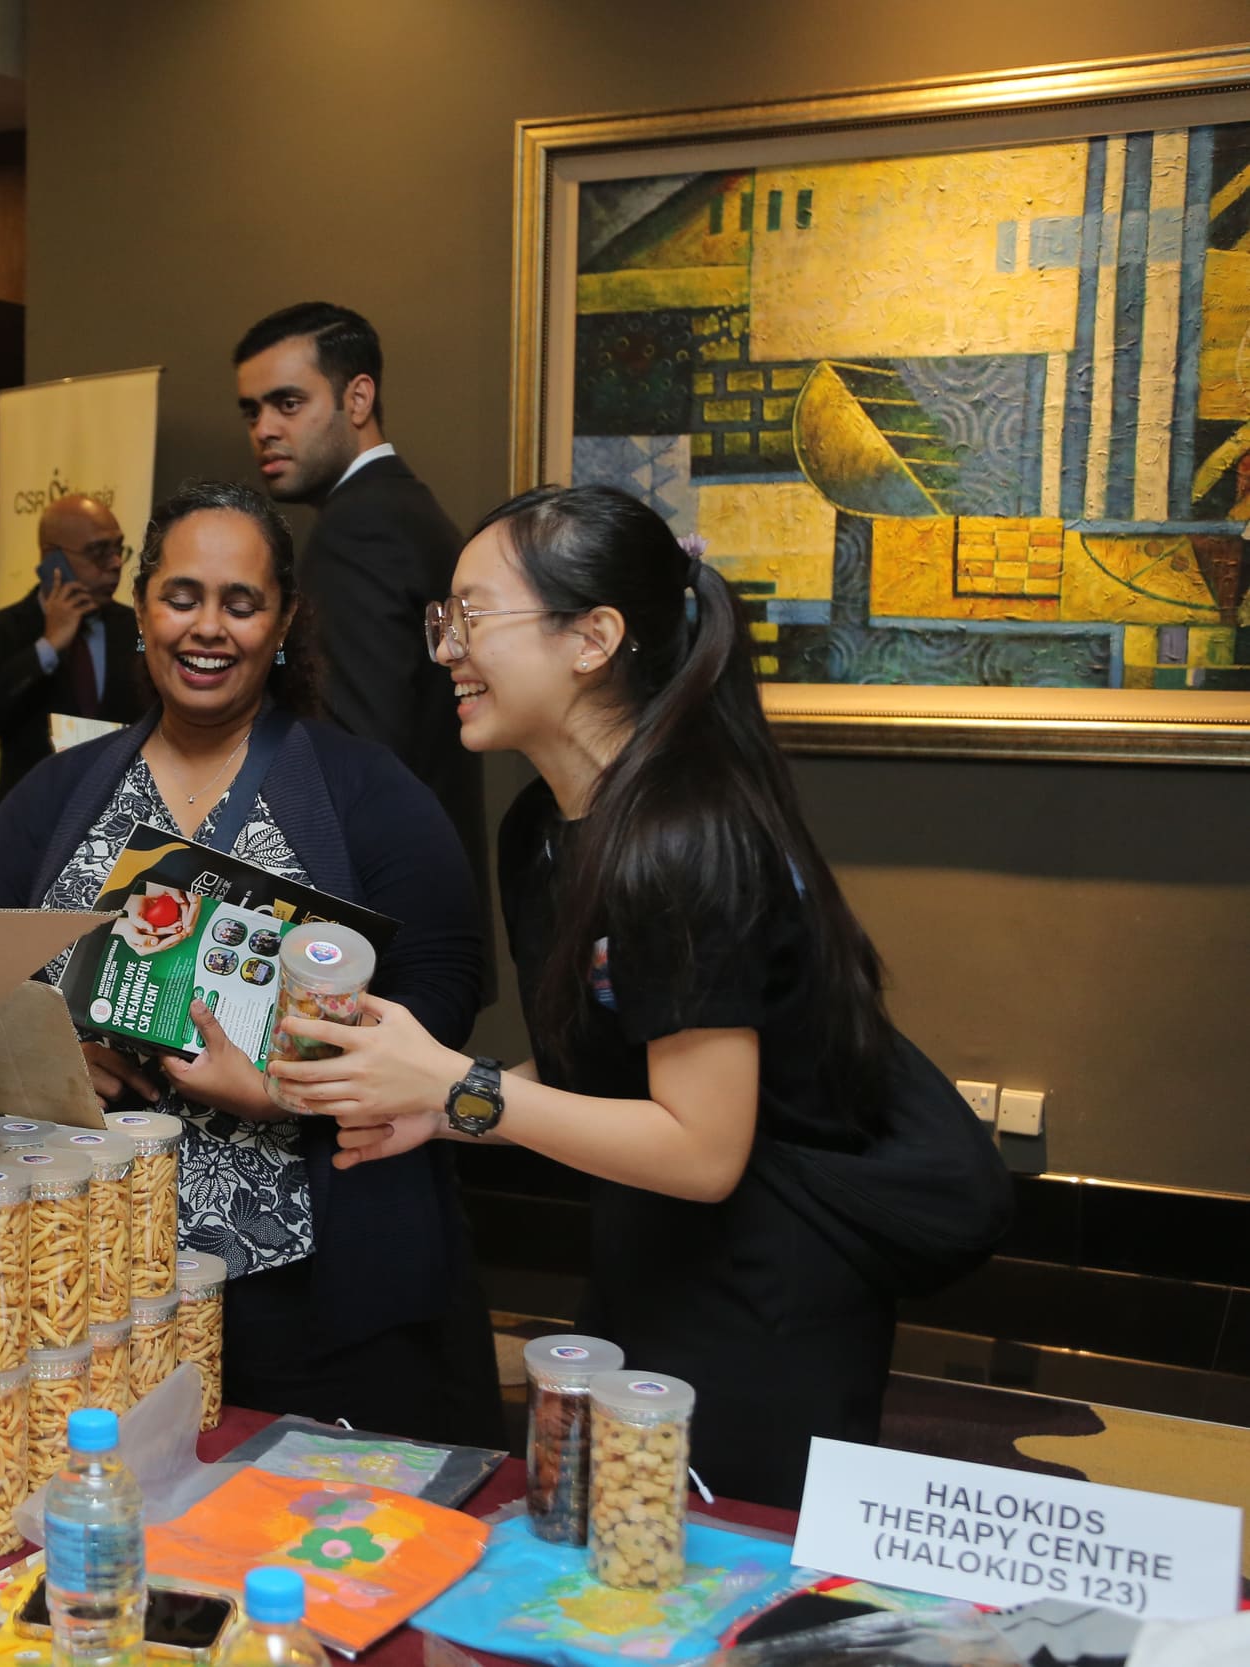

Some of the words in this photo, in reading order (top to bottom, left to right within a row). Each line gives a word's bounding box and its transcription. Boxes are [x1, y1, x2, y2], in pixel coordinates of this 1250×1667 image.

[13, 490, 46, 515] CSR
[112, 981, 131, 1027] SPREADING
[123, 961, 137, 982] LOVE
[126, 960, 152, 1021] MEANINGFUL
[142, 982, 160, 1014] EVENT
[123, 1021, 135, 1031] A
[137, 1014, 152, 1033] CSR
[925, 1480, 1106, 1535] HALOKIDS
[859, 1500, 1017, 1552] THERAPY
[1028, 1532, 1174, 1581] CENTRE
[872, 1532, 1067, 1593] (HALOKIDS
[1081, 1574, 1149, 1614] 123)
